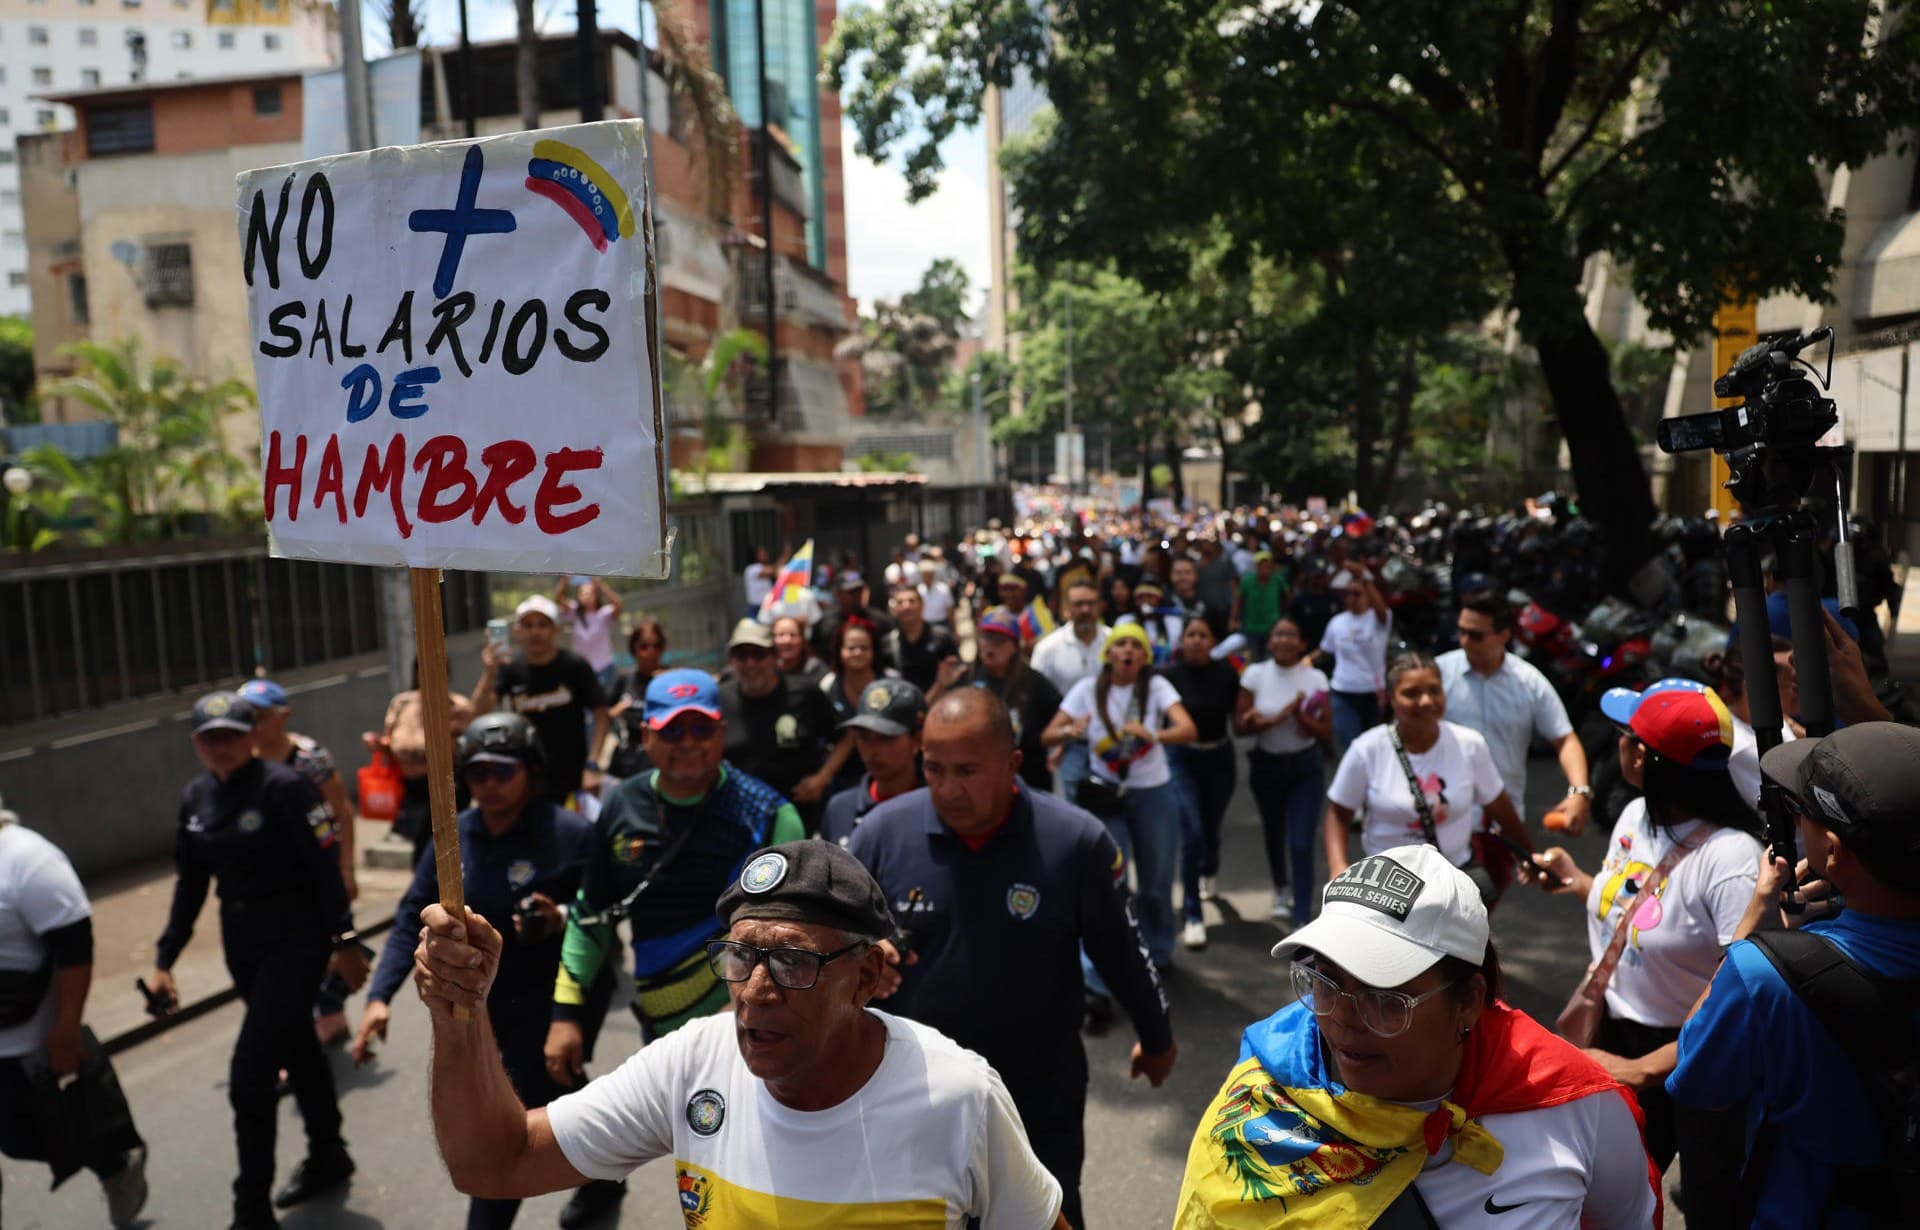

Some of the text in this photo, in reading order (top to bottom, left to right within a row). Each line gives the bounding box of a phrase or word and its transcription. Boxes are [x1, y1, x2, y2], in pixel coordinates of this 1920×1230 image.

[243, 144, 518, 299] NO +
[258, 288, 611, 378] SALARIOS
[340, 363, 442, 424] DE
[264, 431, 605, 539] HAMBRE
[1365, 891, 1408, 915] SERIES
